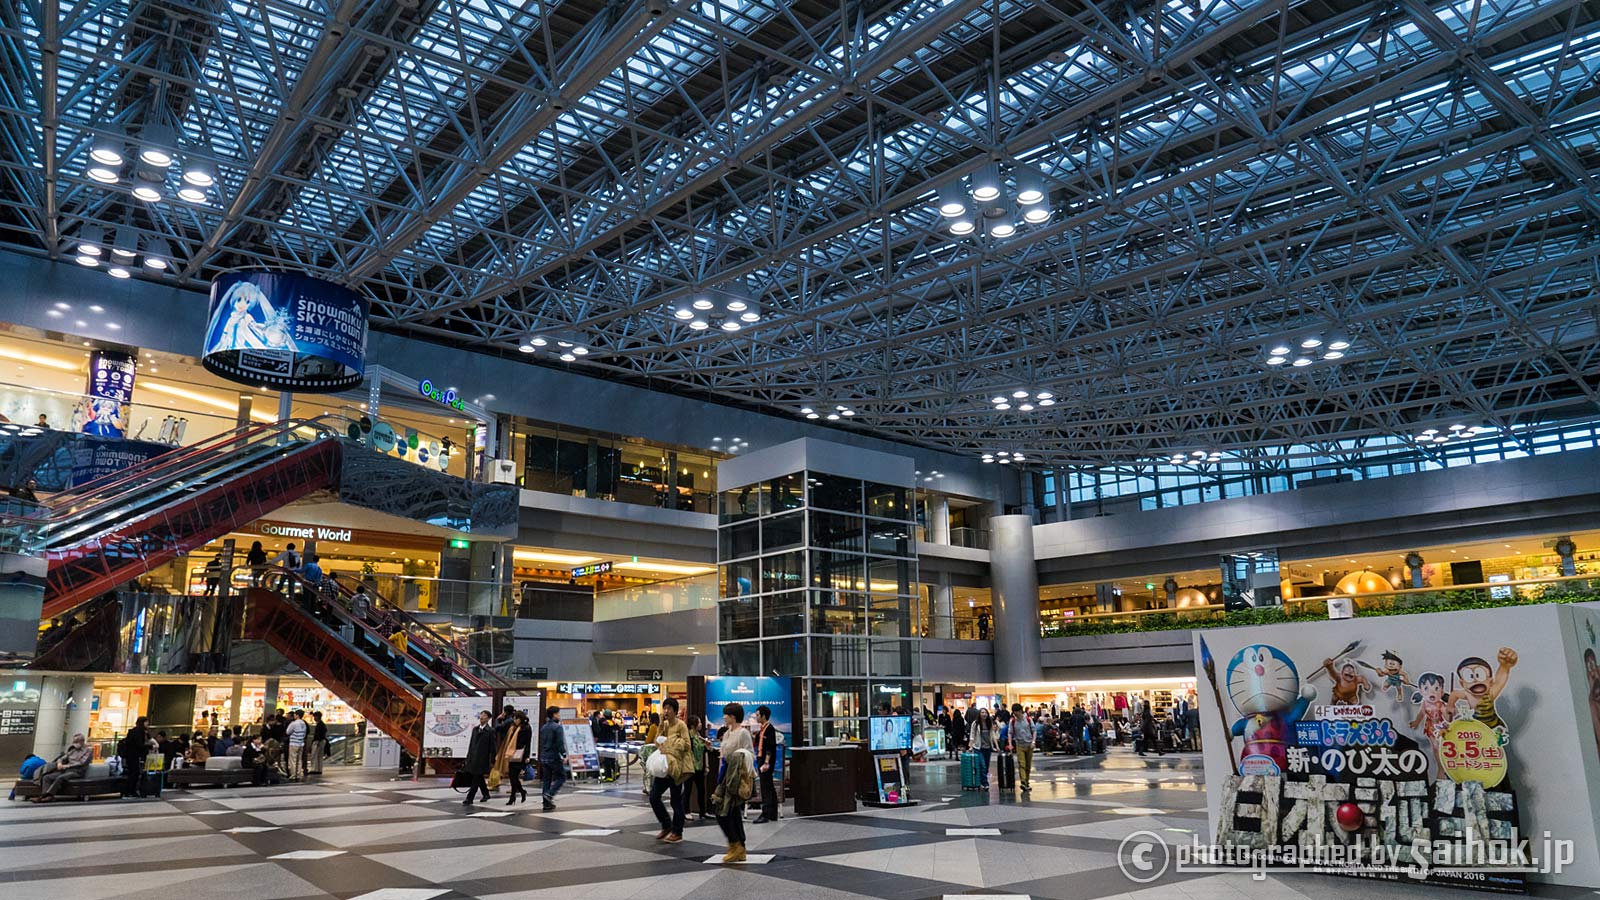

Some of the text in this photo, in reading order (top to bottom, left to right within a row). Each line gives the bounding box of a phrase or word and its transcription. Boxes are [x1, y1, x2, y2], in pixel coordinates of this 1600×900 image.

[261, 523, 315, 539] Gourmet
[317, 527, 352, 542] World
[1315, 705, 1330, 717] 4F
[1297, 720, 1397, 746] 映画 ドラえもん
[1457, 731, 1481, 740] 2016
[1286, 745, 1428, 776] 新・のび太の
[1447, 760, 1503, 769] ロードショー
[1436, 871, 1462, 879] JAPAN
[1464, 872, 1485, 880] 2016
